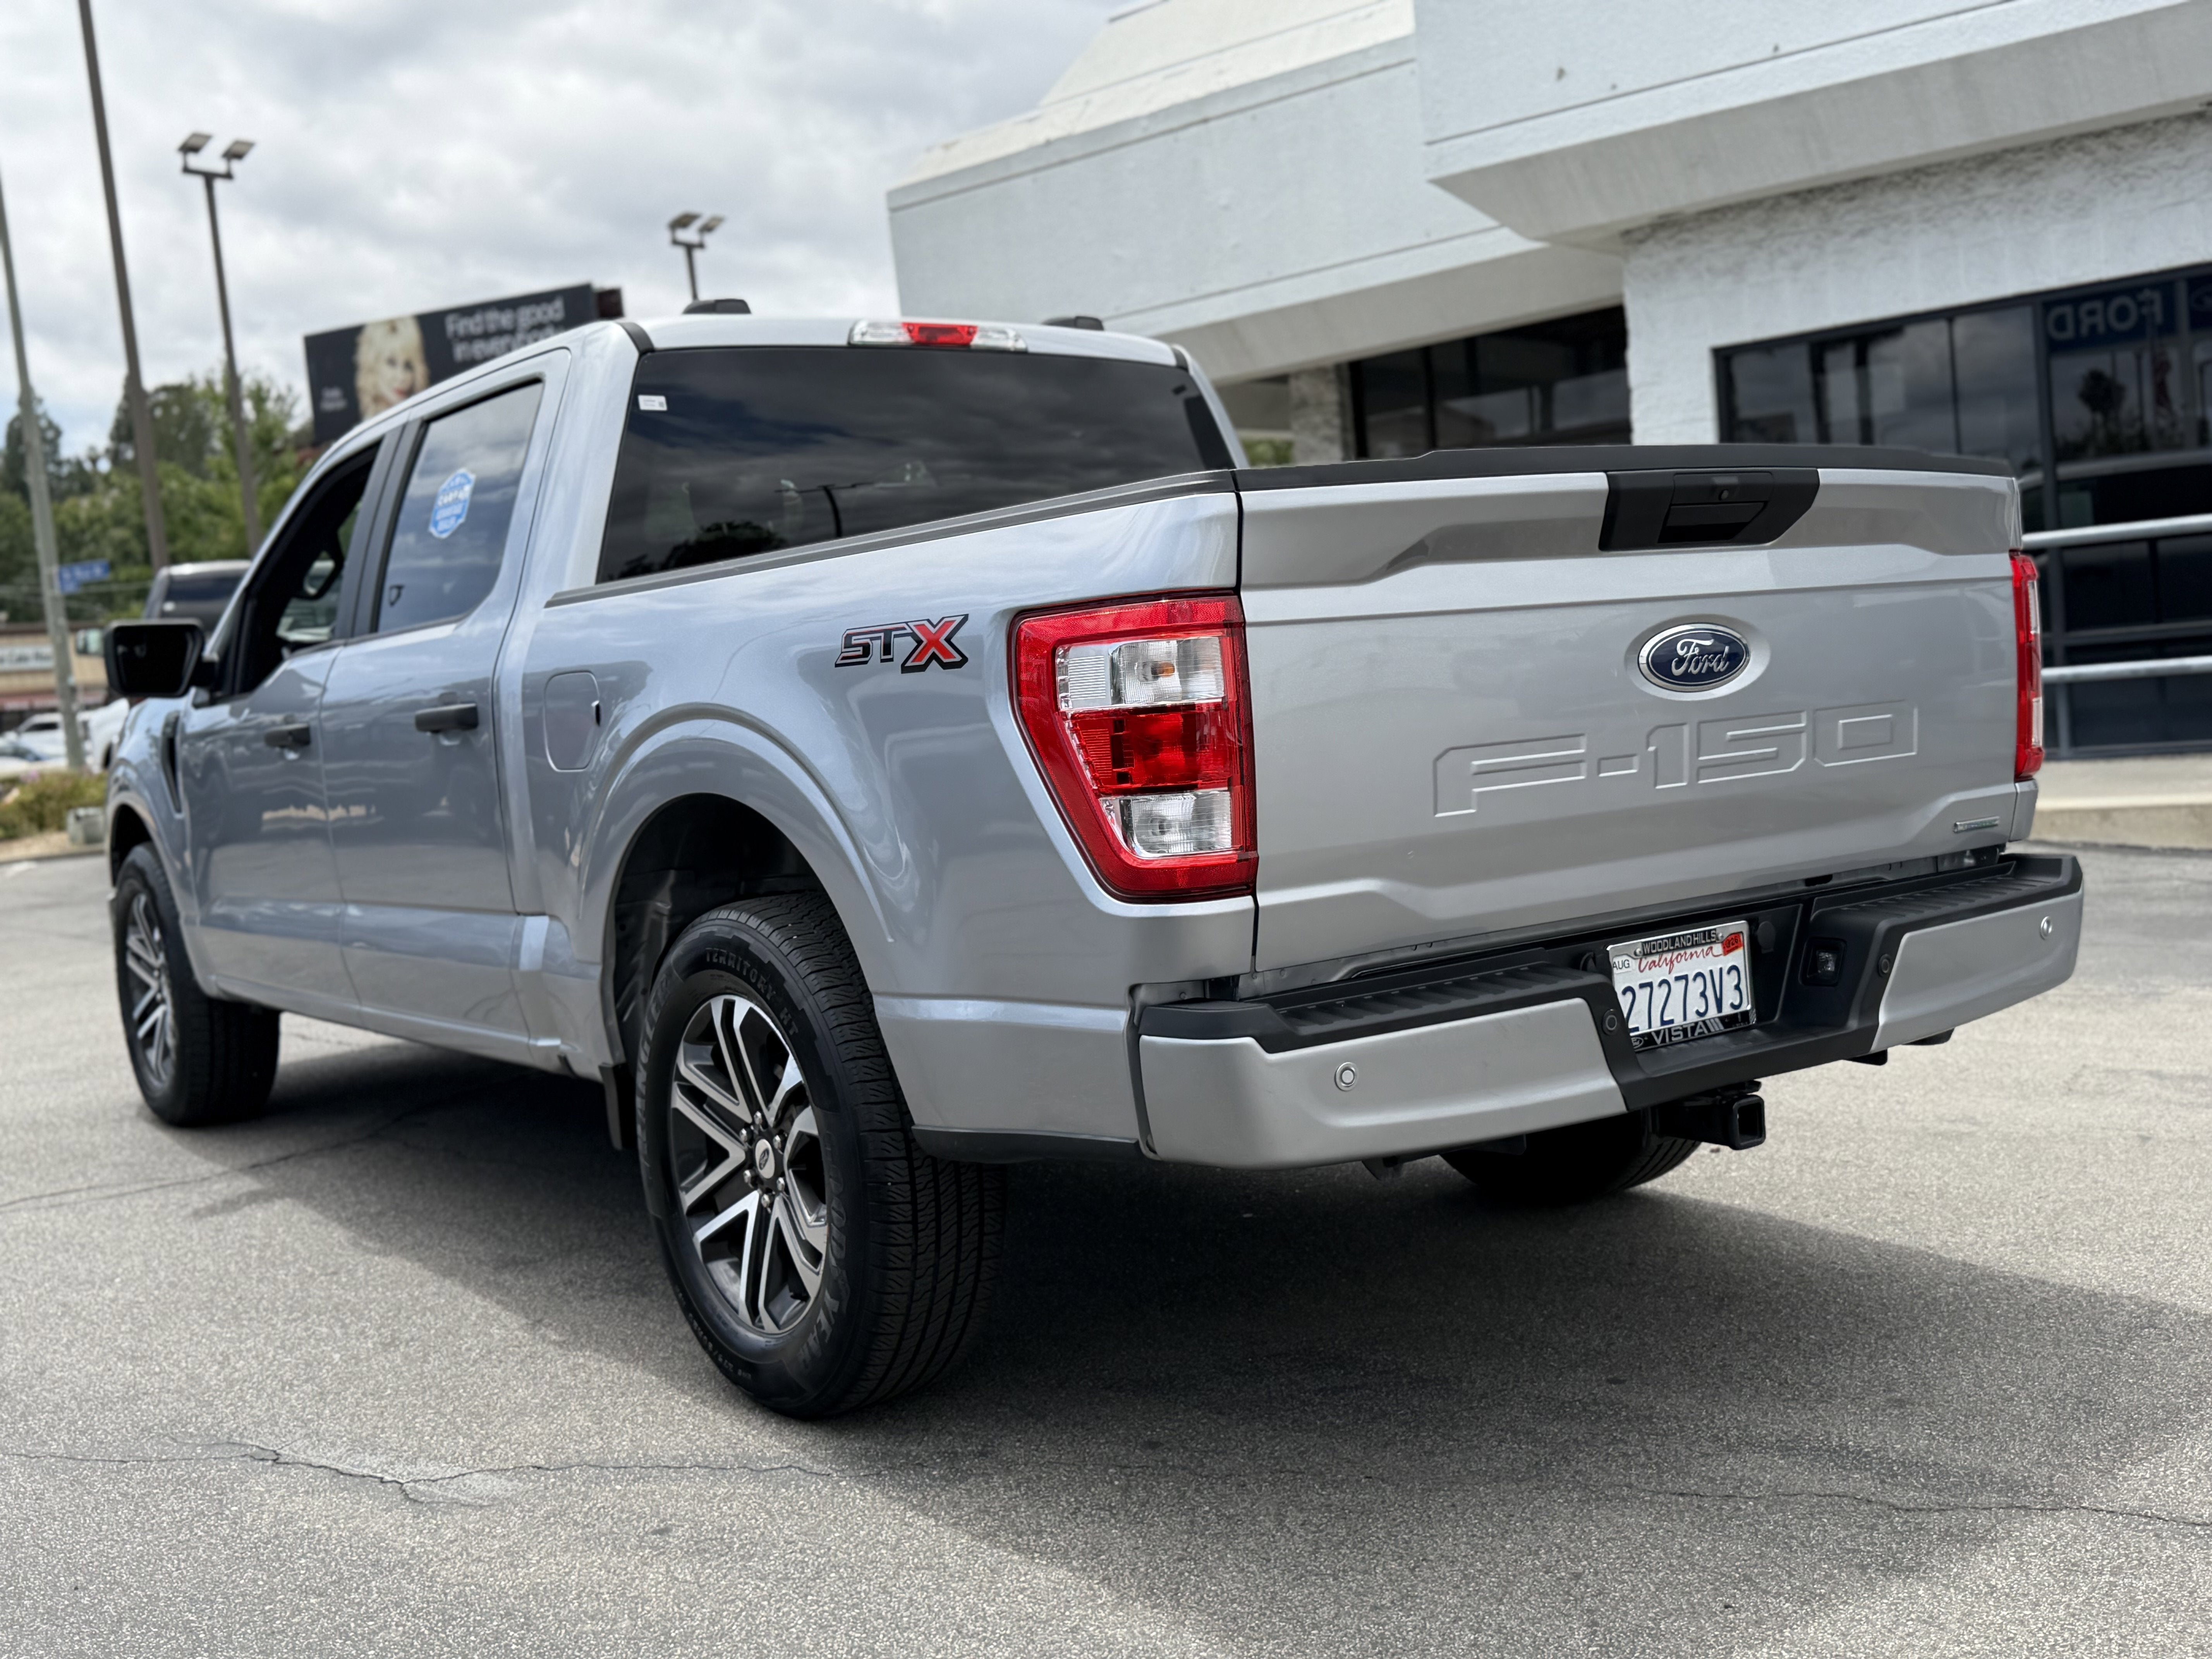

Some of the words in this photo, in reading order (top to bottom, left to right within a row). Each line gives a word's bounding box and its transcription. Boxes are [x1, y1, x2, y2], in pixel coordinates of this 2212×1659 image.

[445, 312, 483, 338] Find
[484, 308, 514, 331] the
[517, 295, 565, 328] good
[835, 614, 969, 673] STX
[1672, 639, 1730, 676] Ford
[1433, 699, 1918, 816] F-150
[1638, 945, 1723, 974] California
[1644, 934, 1693, 954] WOODLAND
[1693, 930, 1716, 945] HILLS
[705, 947, 776, 1000] TERRITORY
[1613, 959, 1630, 970] AUG
[1621, 964, 1743, 1033] 27273V3
[1651, 1021, 1709, 1045] VISTA
